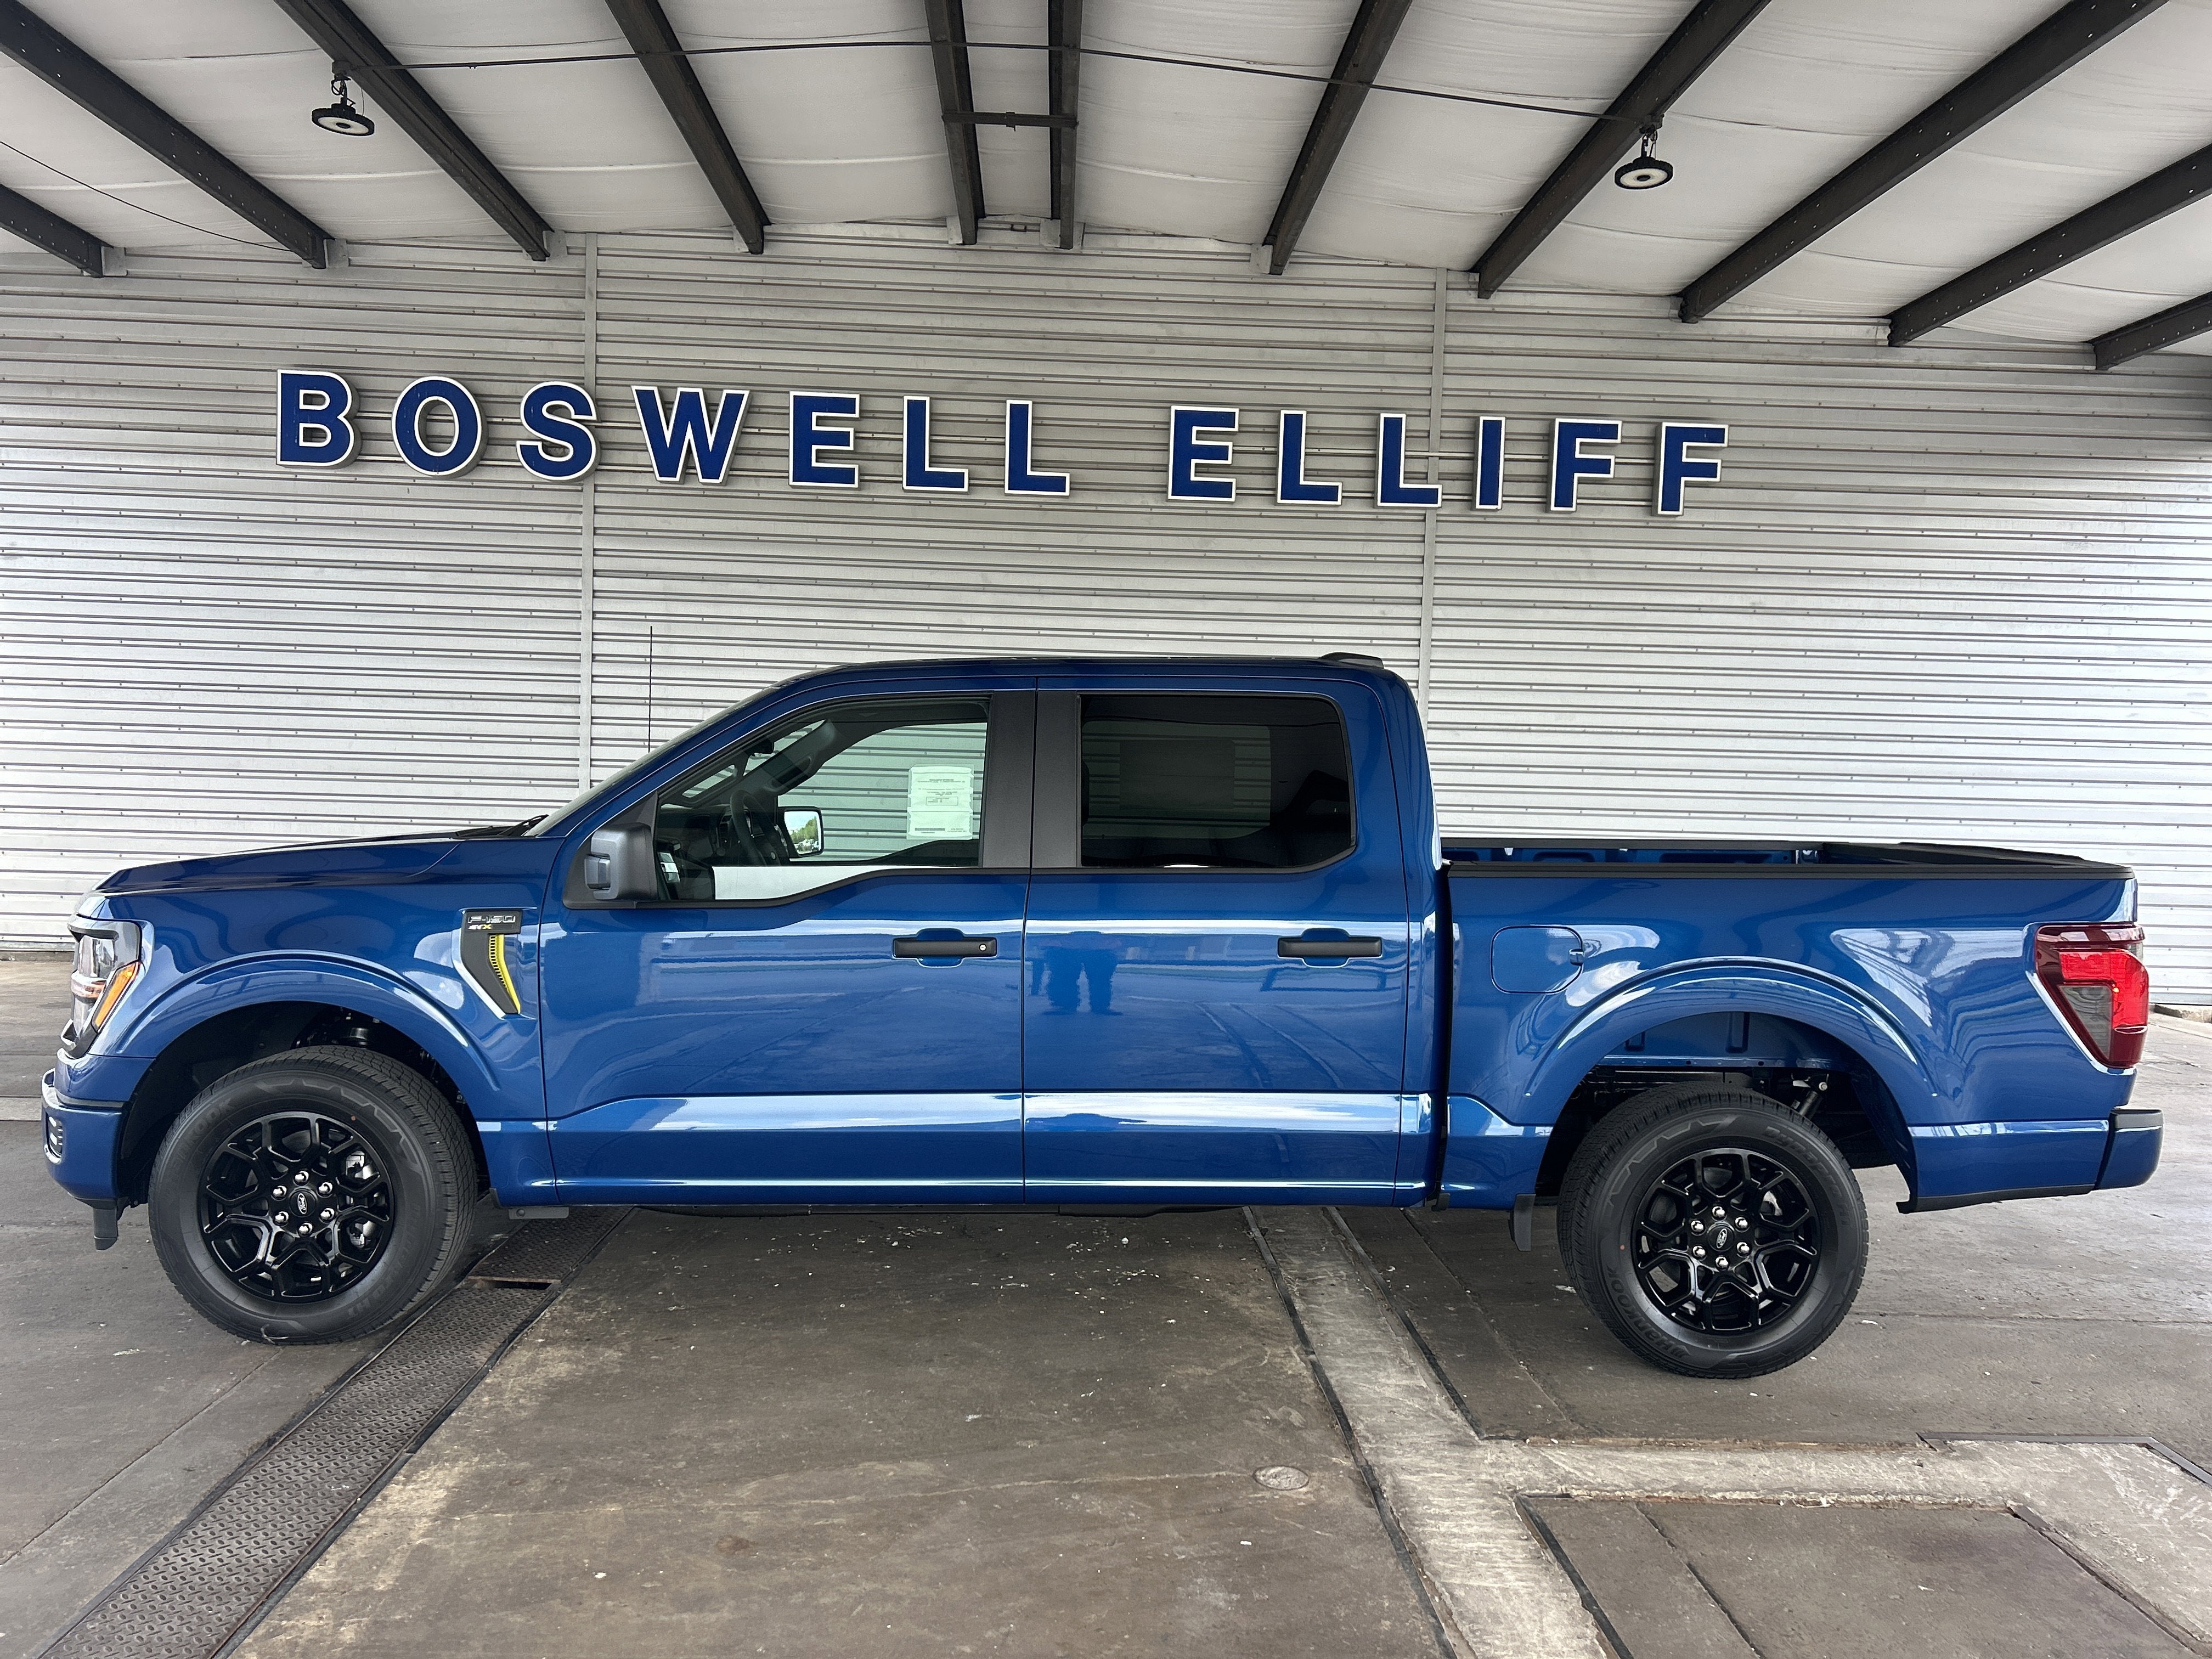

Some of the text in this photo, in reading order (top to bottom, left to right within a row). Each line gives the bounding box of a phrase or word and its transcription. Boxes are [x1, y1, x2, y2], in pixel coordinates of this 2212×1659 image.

[276, 369, 1729, 515] BOSWELL ELLIFF
[467, 915, 516, 923] F-150
